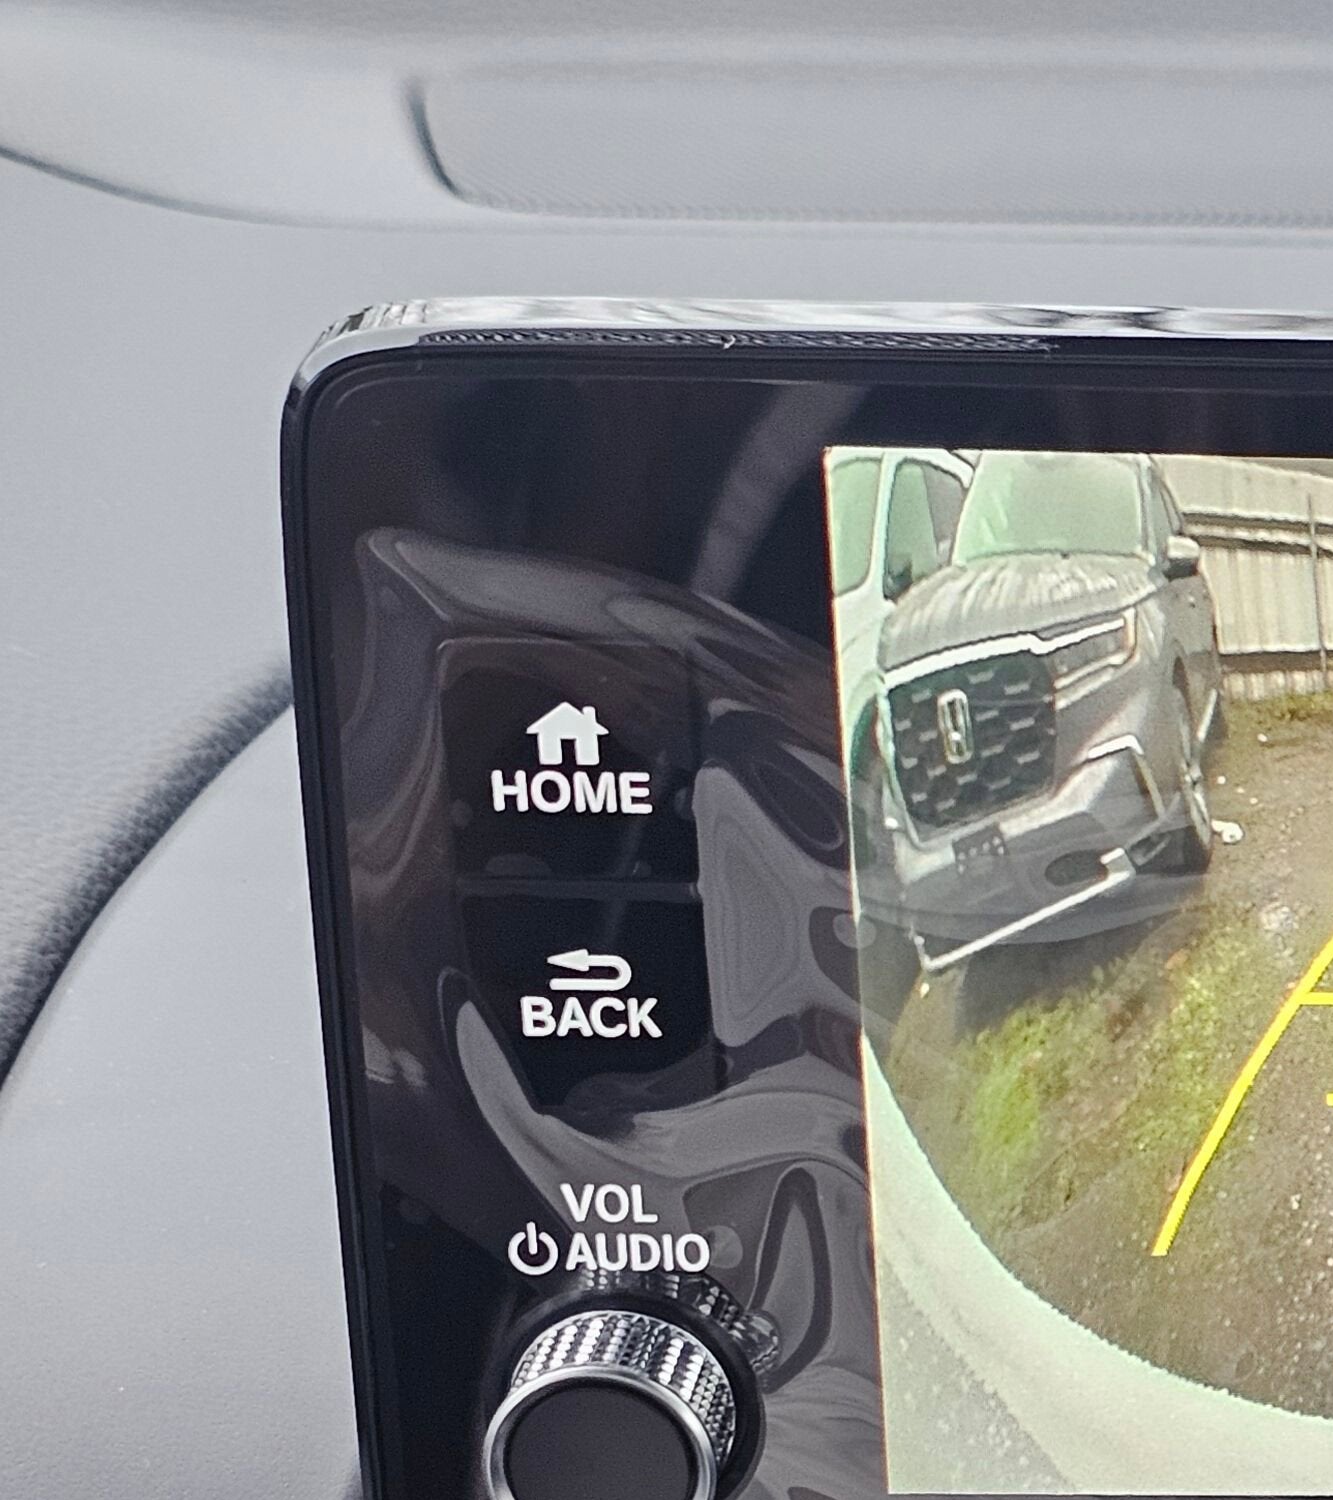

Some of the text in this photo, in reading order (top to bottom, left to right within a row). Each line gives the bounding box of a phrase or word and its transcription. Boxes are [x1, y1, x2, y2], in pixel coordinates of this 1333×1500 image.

[490, 769, 653, 814] HOME
[520, 995, 663, 1038] BACK
[560, 1183, 658, 1223] VOL
[565, 1232, 710, 1272] AUDIO
